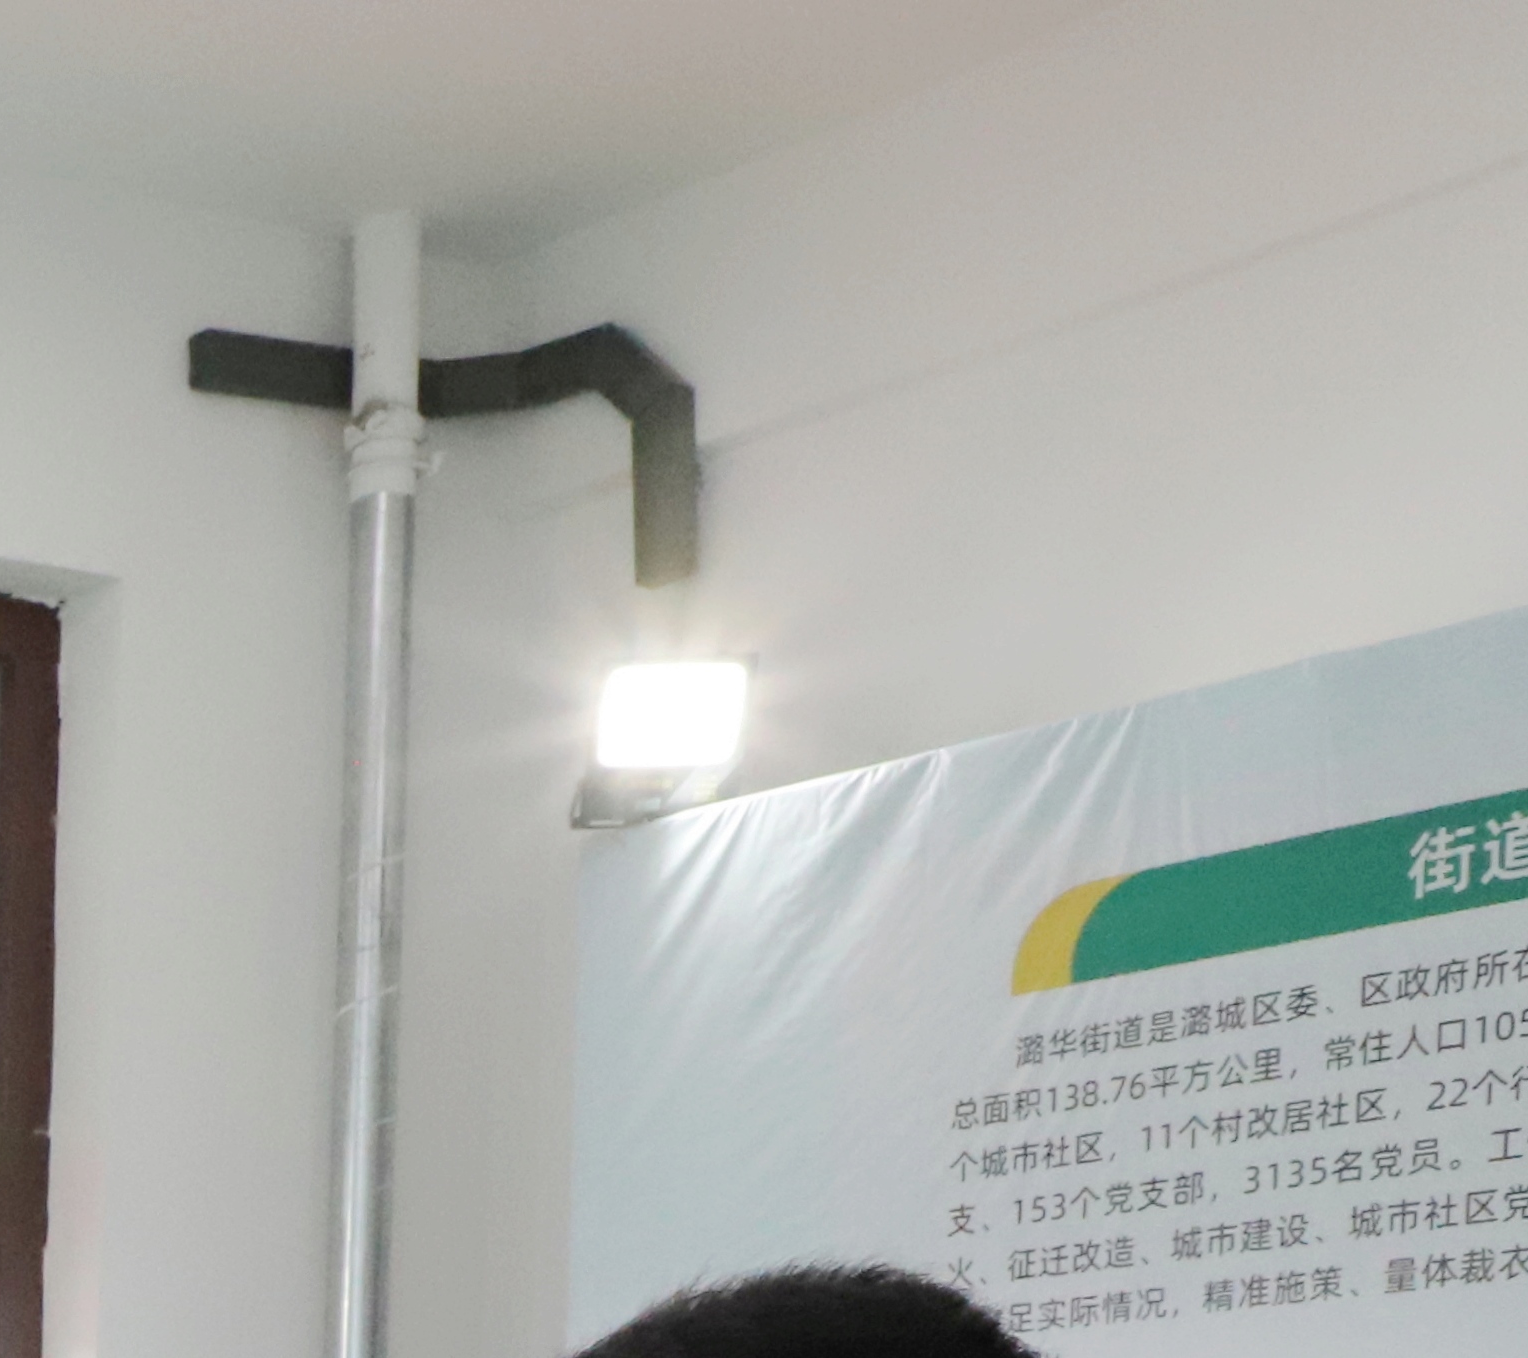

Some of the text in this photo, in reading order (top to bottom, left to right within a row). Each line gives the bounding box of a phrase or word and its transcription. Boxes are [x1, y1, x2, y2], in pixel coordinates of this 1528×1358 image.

[1000, 1244, 1528, 1334] 足实际情况，精准施策、量体裁衣
